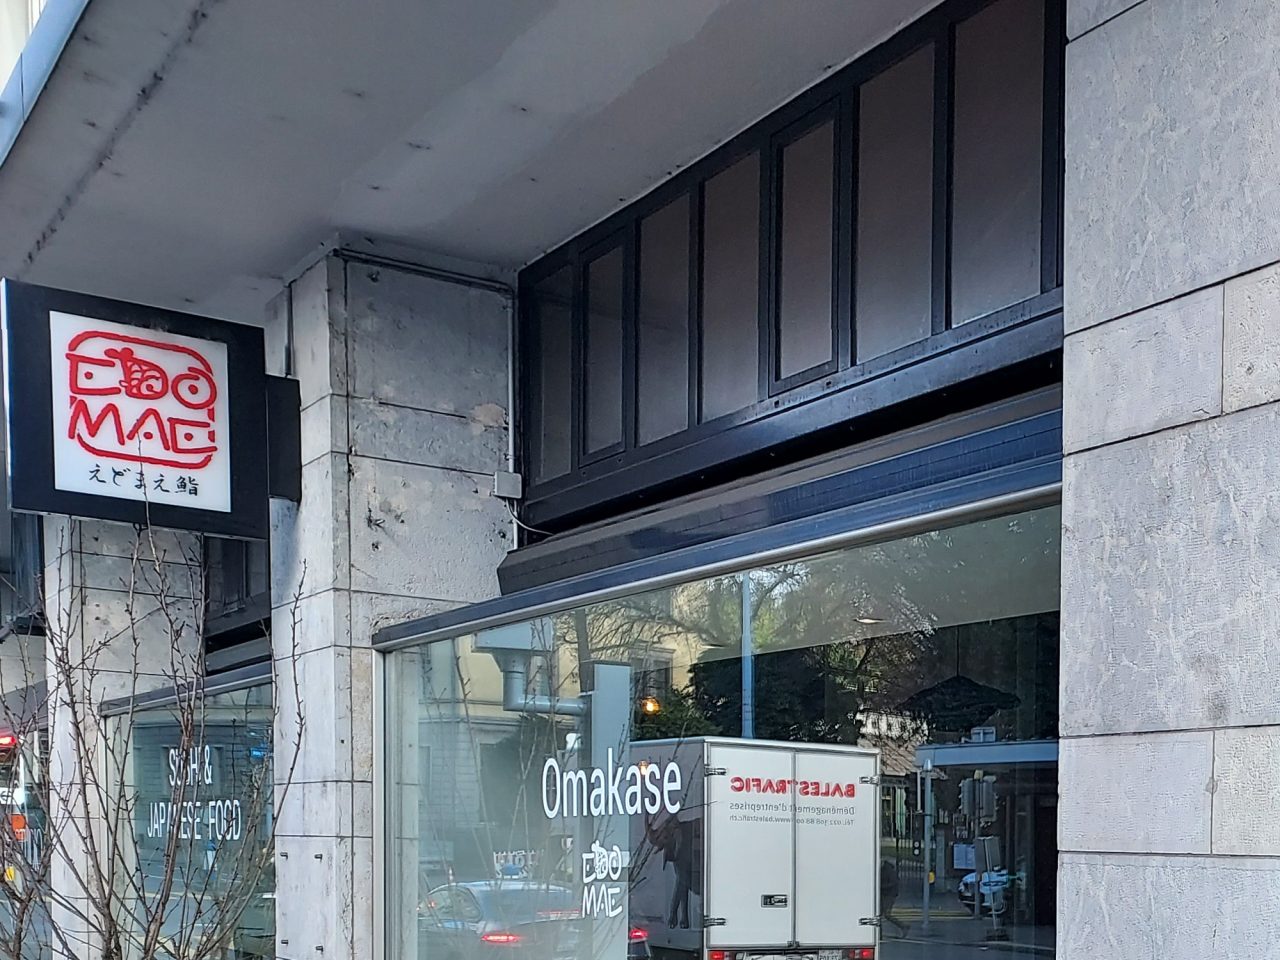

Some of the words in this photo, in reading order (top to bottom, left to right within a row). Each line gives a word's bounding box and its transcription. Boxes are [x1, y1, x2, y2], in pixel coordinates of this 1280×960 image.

[68, 402, 218, 453] MAE
[88, 463, 200, 497] えどまえ鮨
[169, 747, 202, 787] SUH
[541, 747, 682, 819] Omakase
[581, 884, 623, 918] MAE
